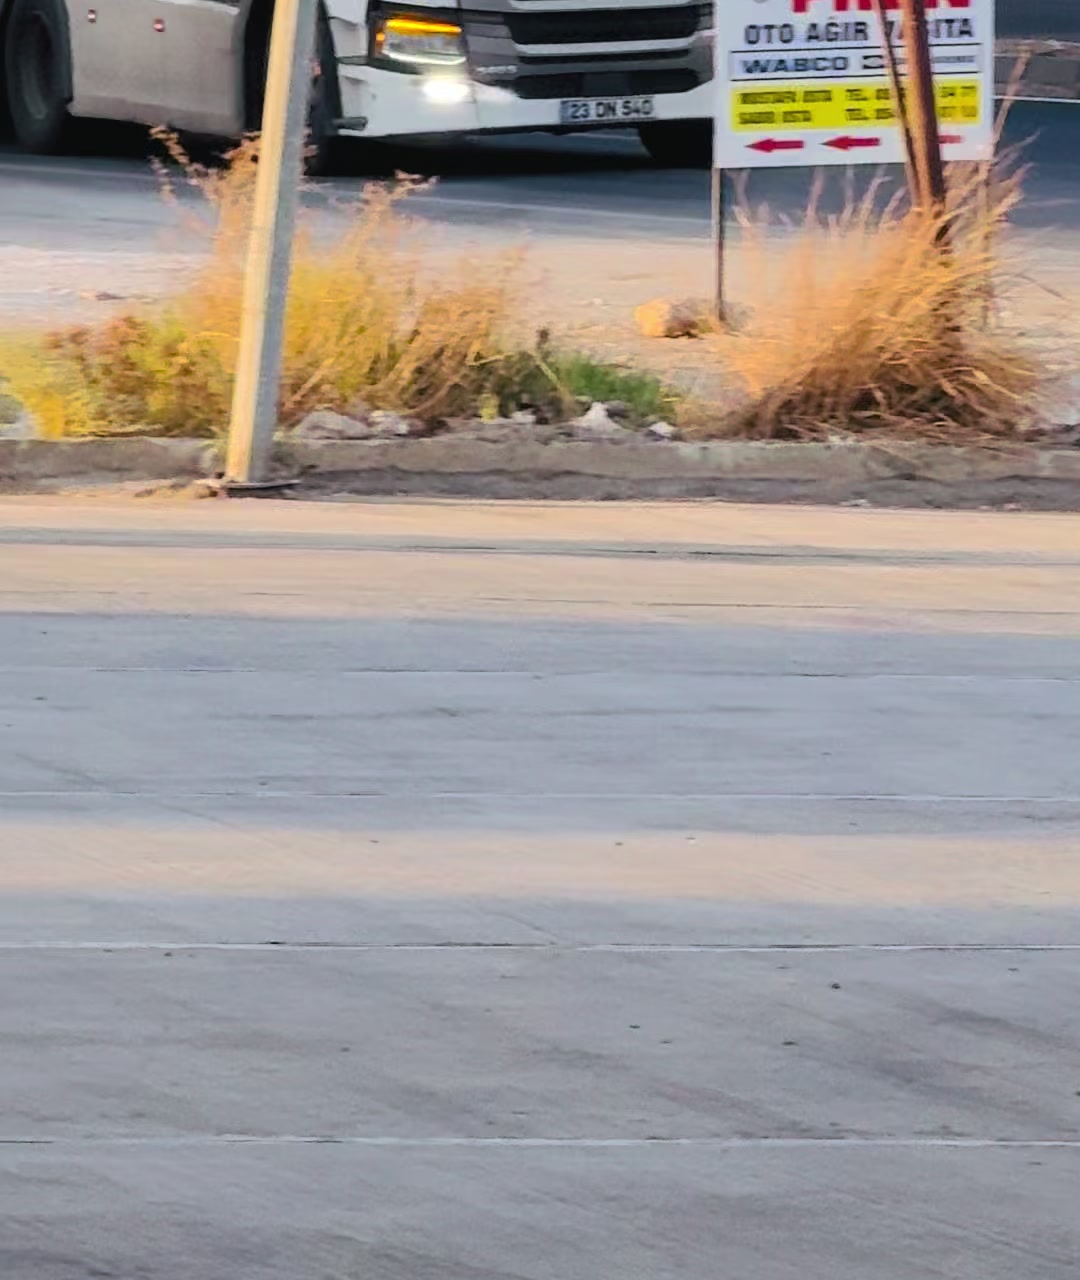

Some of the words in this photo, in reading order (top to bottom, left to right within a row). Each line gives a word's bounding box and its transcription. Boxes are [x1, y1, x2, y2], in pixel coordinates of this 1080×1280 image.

[744, 23, 794, 45] OTO
[882, 18, 974, 41] VITA
[742, 56, 849, 74] WABCO
[571, 102, 590, 119] 23
